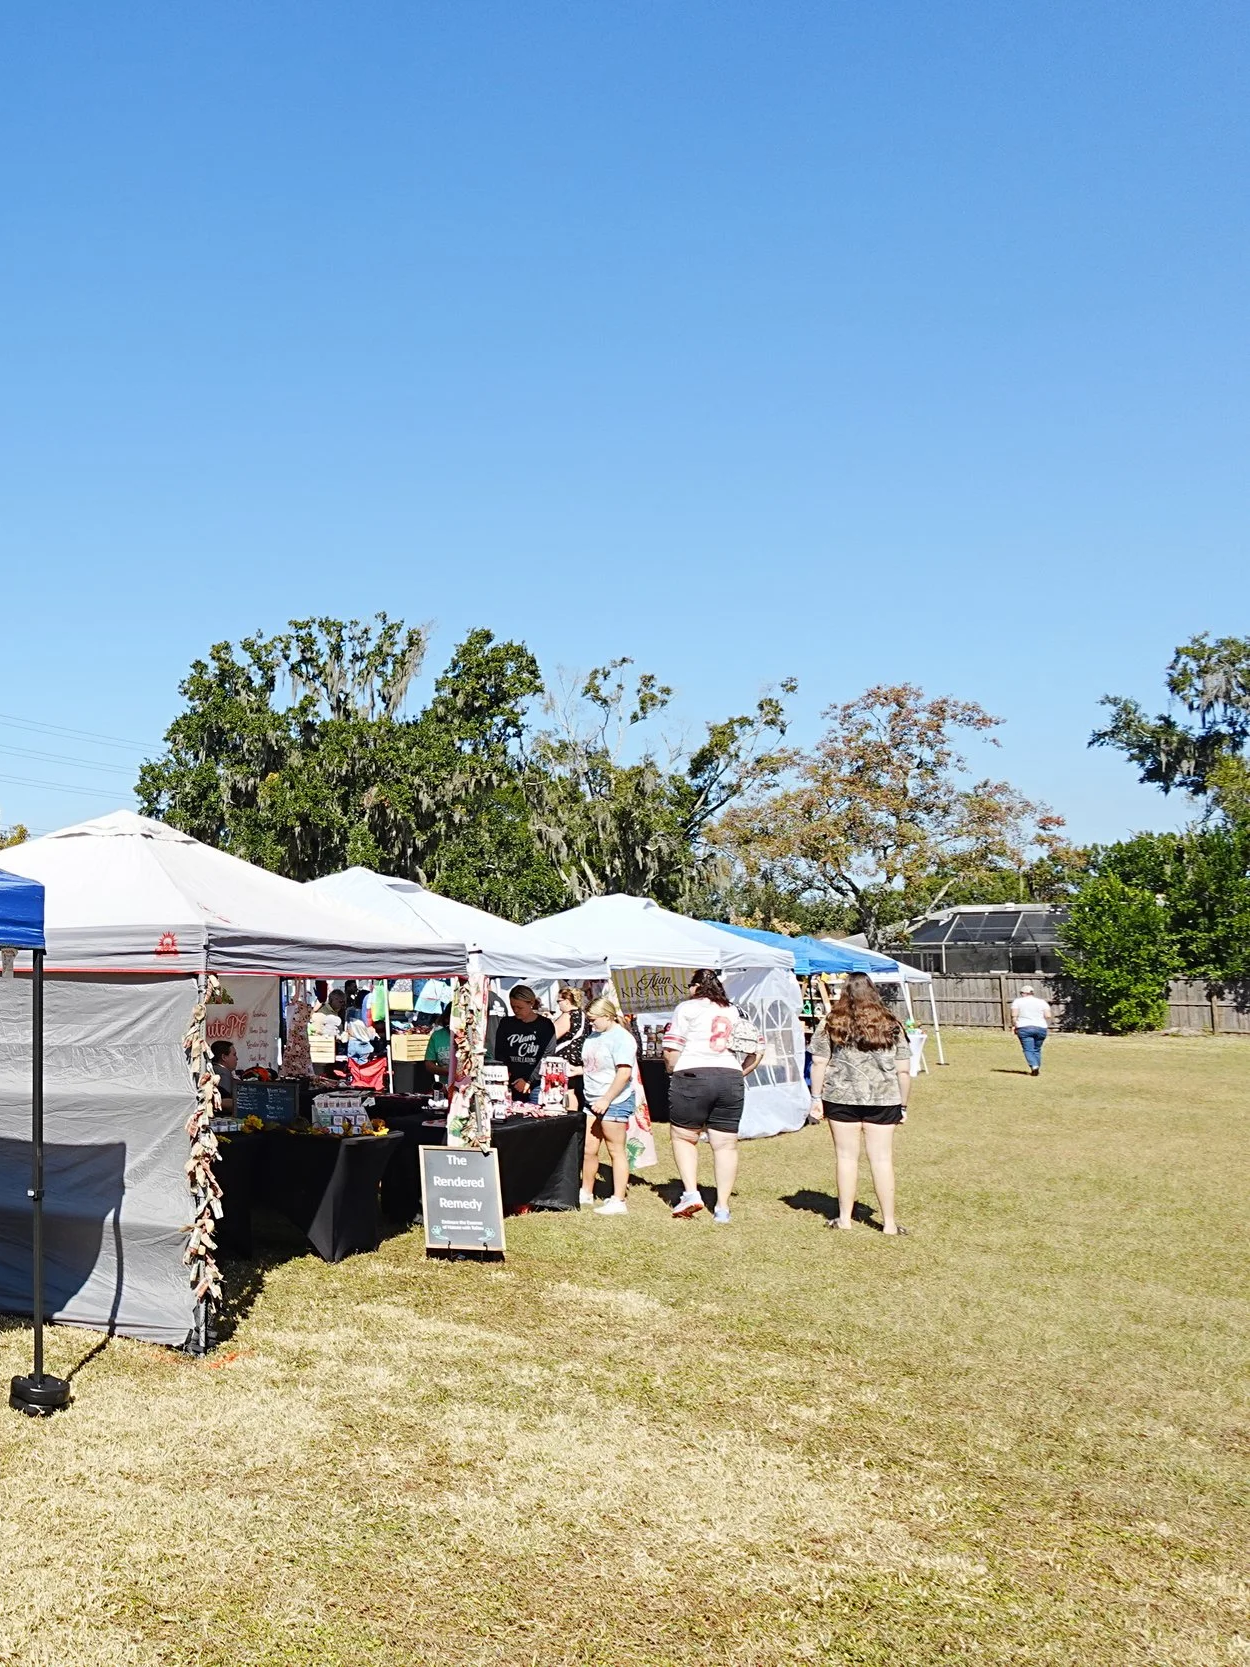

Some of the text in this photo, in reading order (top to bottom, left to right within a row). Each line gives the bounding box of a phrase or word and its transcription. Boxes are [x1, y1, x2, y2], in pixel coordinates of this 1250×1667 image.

[518, 1042, 539, 1057] City
[446, 1154, 467, 1166] The
[433, 1176, 485, 1188] Rendered
[439, 1198, 482, 1212] Remedy
